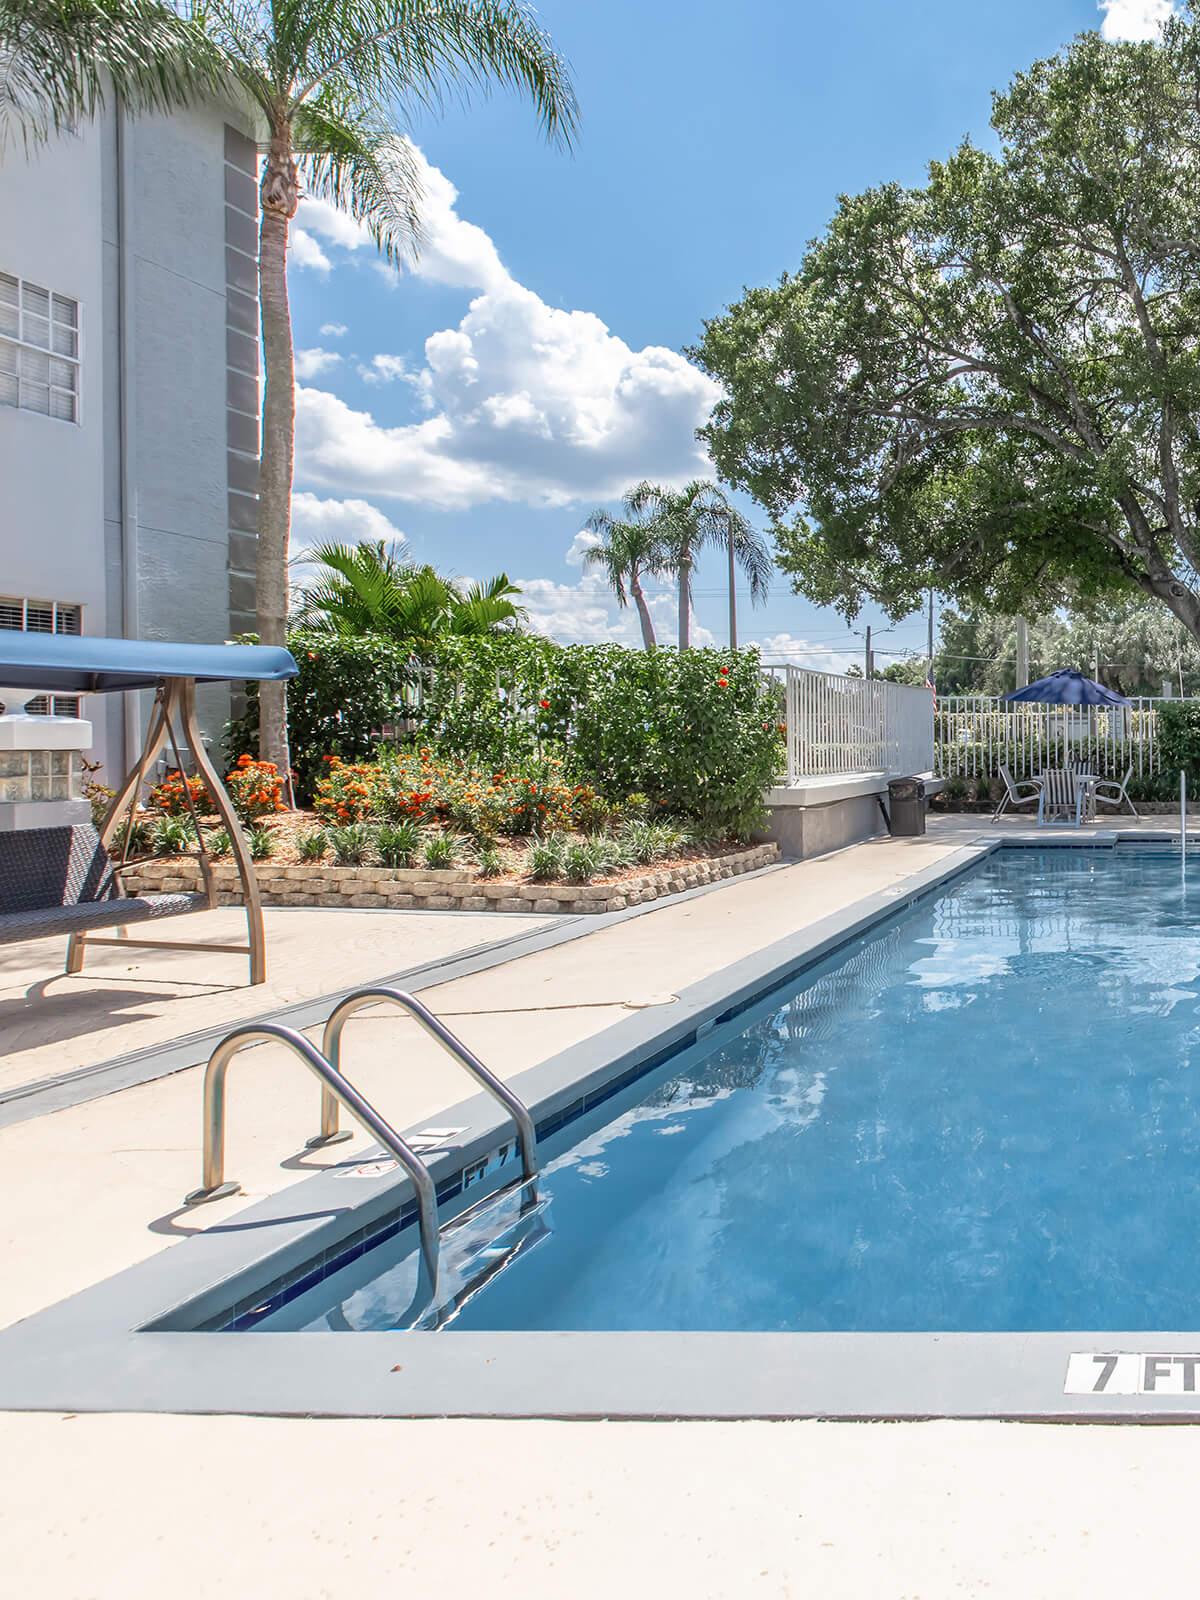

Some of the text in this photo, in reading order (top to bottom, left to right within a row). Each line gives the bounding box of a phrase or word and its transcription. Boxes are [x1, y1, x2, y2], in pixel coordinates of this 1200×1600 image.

[464, 1145, 508, 1188] FT 7
[1092, 1356, 1118, 1392] 7
